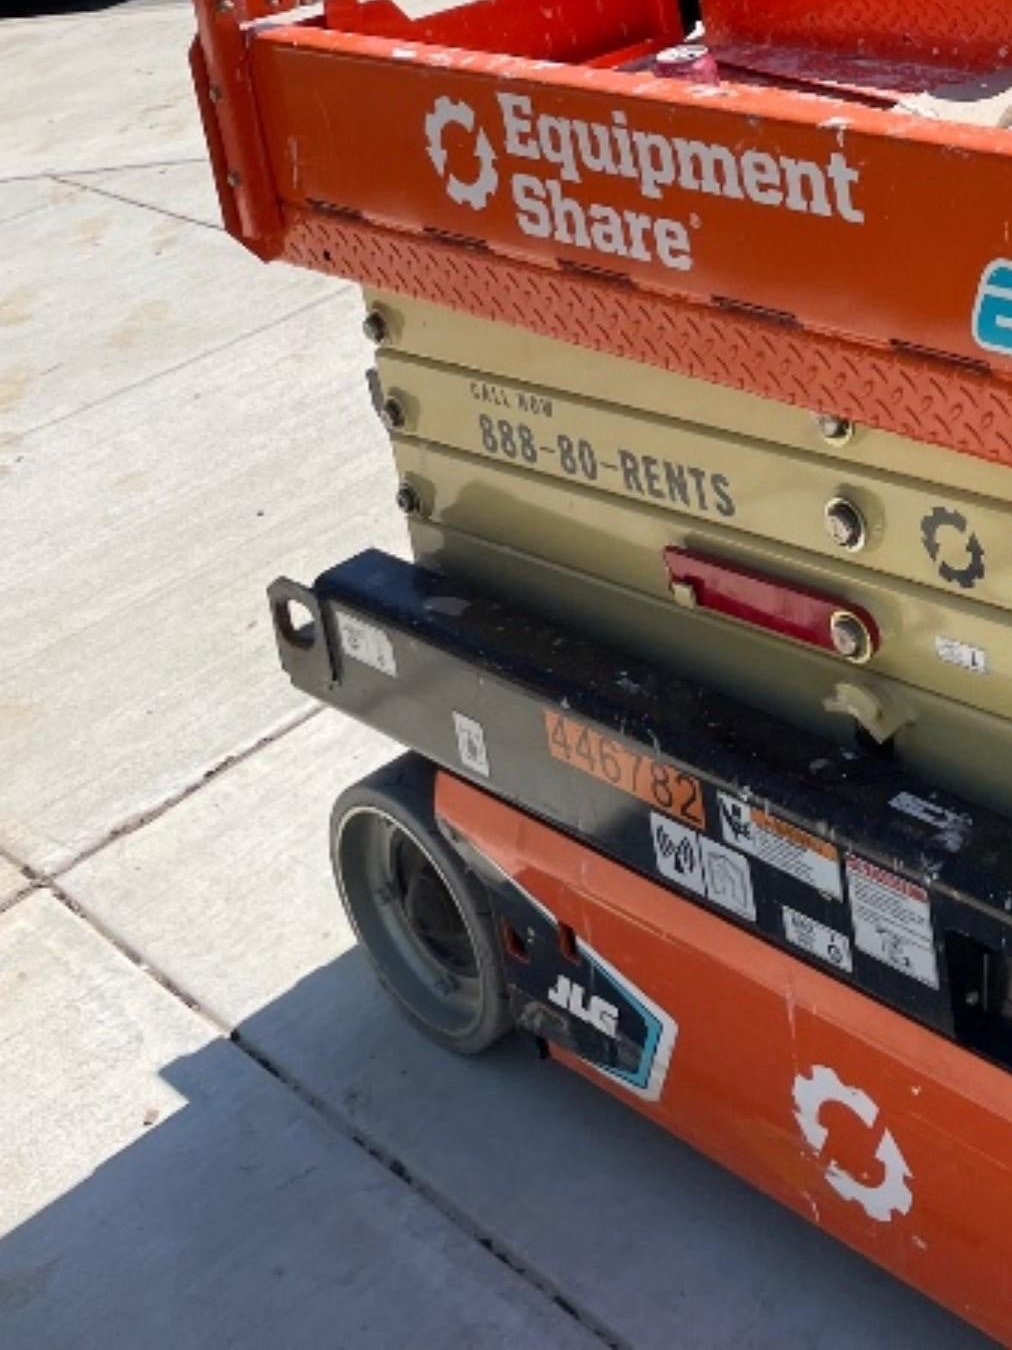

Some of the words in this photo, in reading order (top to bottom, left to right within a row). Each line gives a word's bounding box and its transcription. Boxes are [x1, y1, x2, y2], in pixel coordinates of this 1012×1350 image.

[496, 91, 866, 224] Equipment
[511, 172, 694, 272] Share
[470, 382, 511, 409] CALL
[517, 392, 553, 418] NOW
[478, 412, 736, 518] 888-80-RENTS
[551, 716, 702, 823] 446782
[548, 974, 619, 1039] JLG
